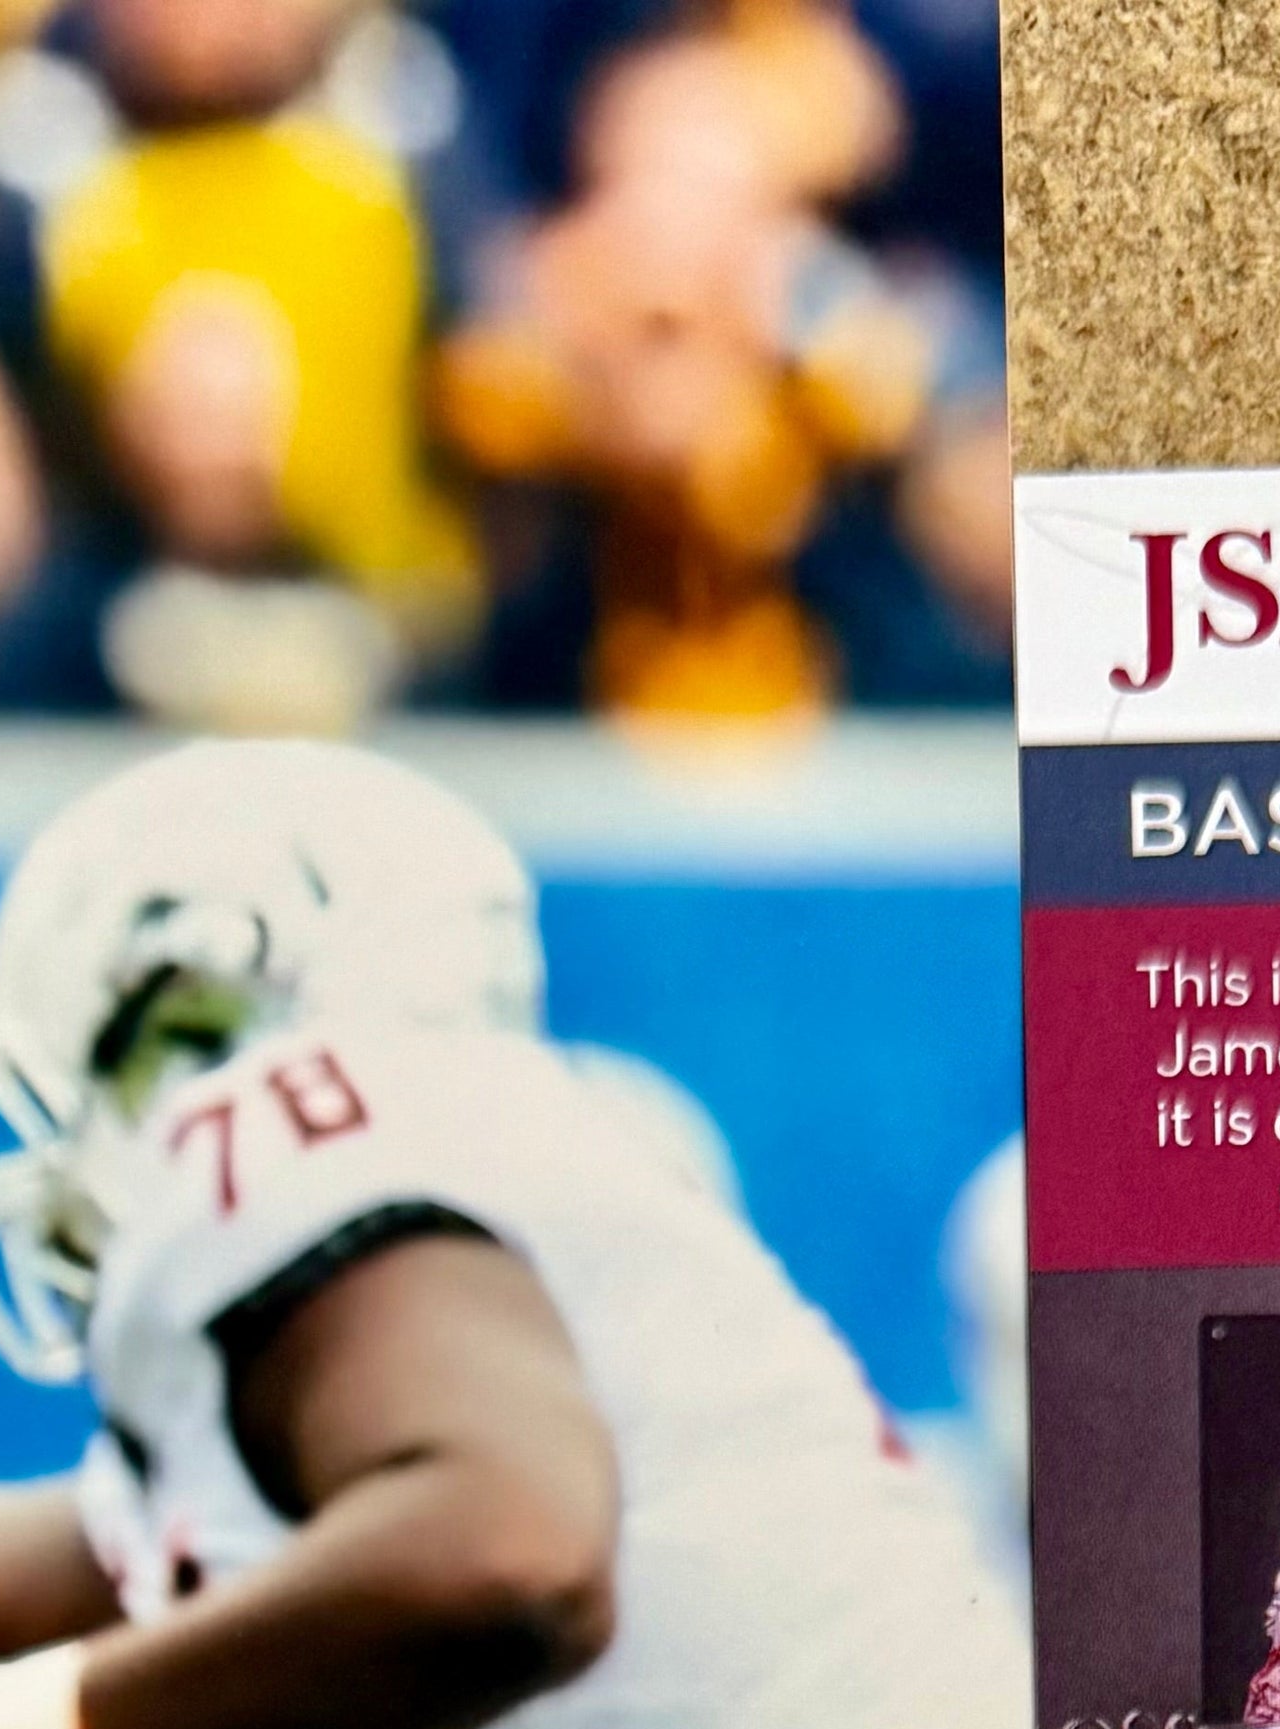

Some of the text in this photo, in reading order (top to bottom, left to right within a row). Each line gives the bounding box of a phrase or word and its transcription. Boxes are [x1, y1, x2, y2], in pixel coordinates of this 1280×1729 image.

[1136, 958, 1250, 1009] This
[1157, 1099, 1193, 1147] it
[1213, 1099, 1254, 1146] is
